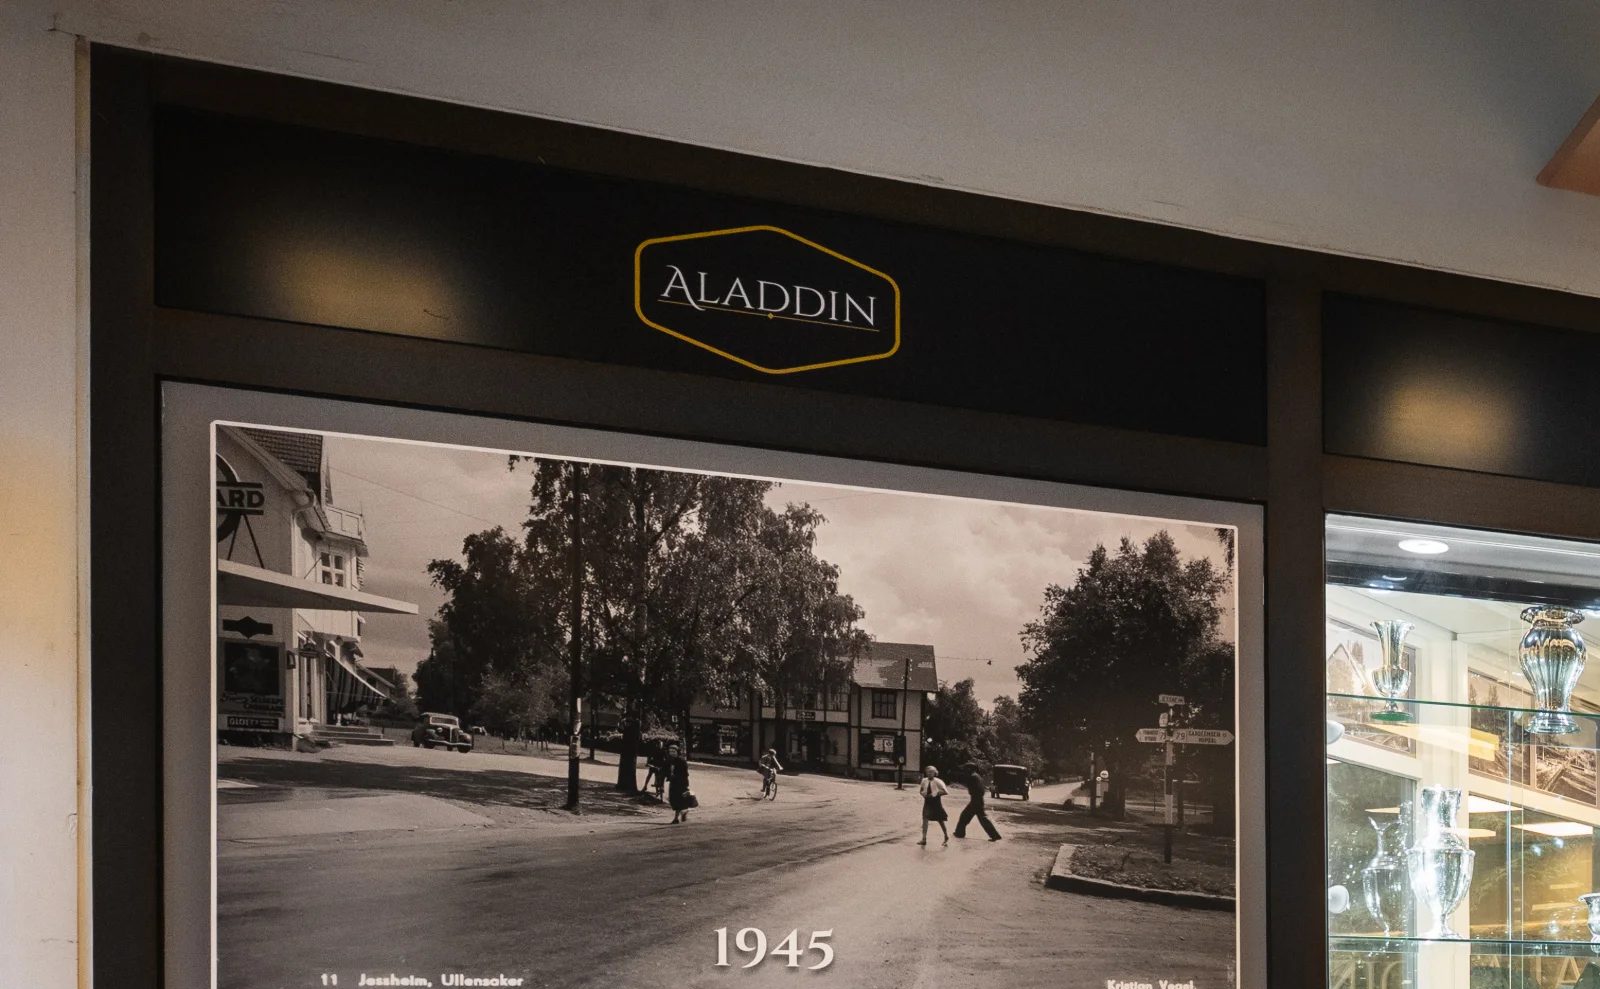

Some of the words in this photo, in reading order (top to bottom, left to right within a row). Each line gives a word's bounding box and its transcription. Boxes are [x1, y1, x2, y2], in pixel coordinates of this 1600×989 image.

[660, 264, 878, 327] ALADDIN
[713, 926, 834, 970] 1945
[320, 973, 338, 986] 11
[358, 973, 433, 988] Jessheim,
[441, 973, 524, 987] Ullensaker
